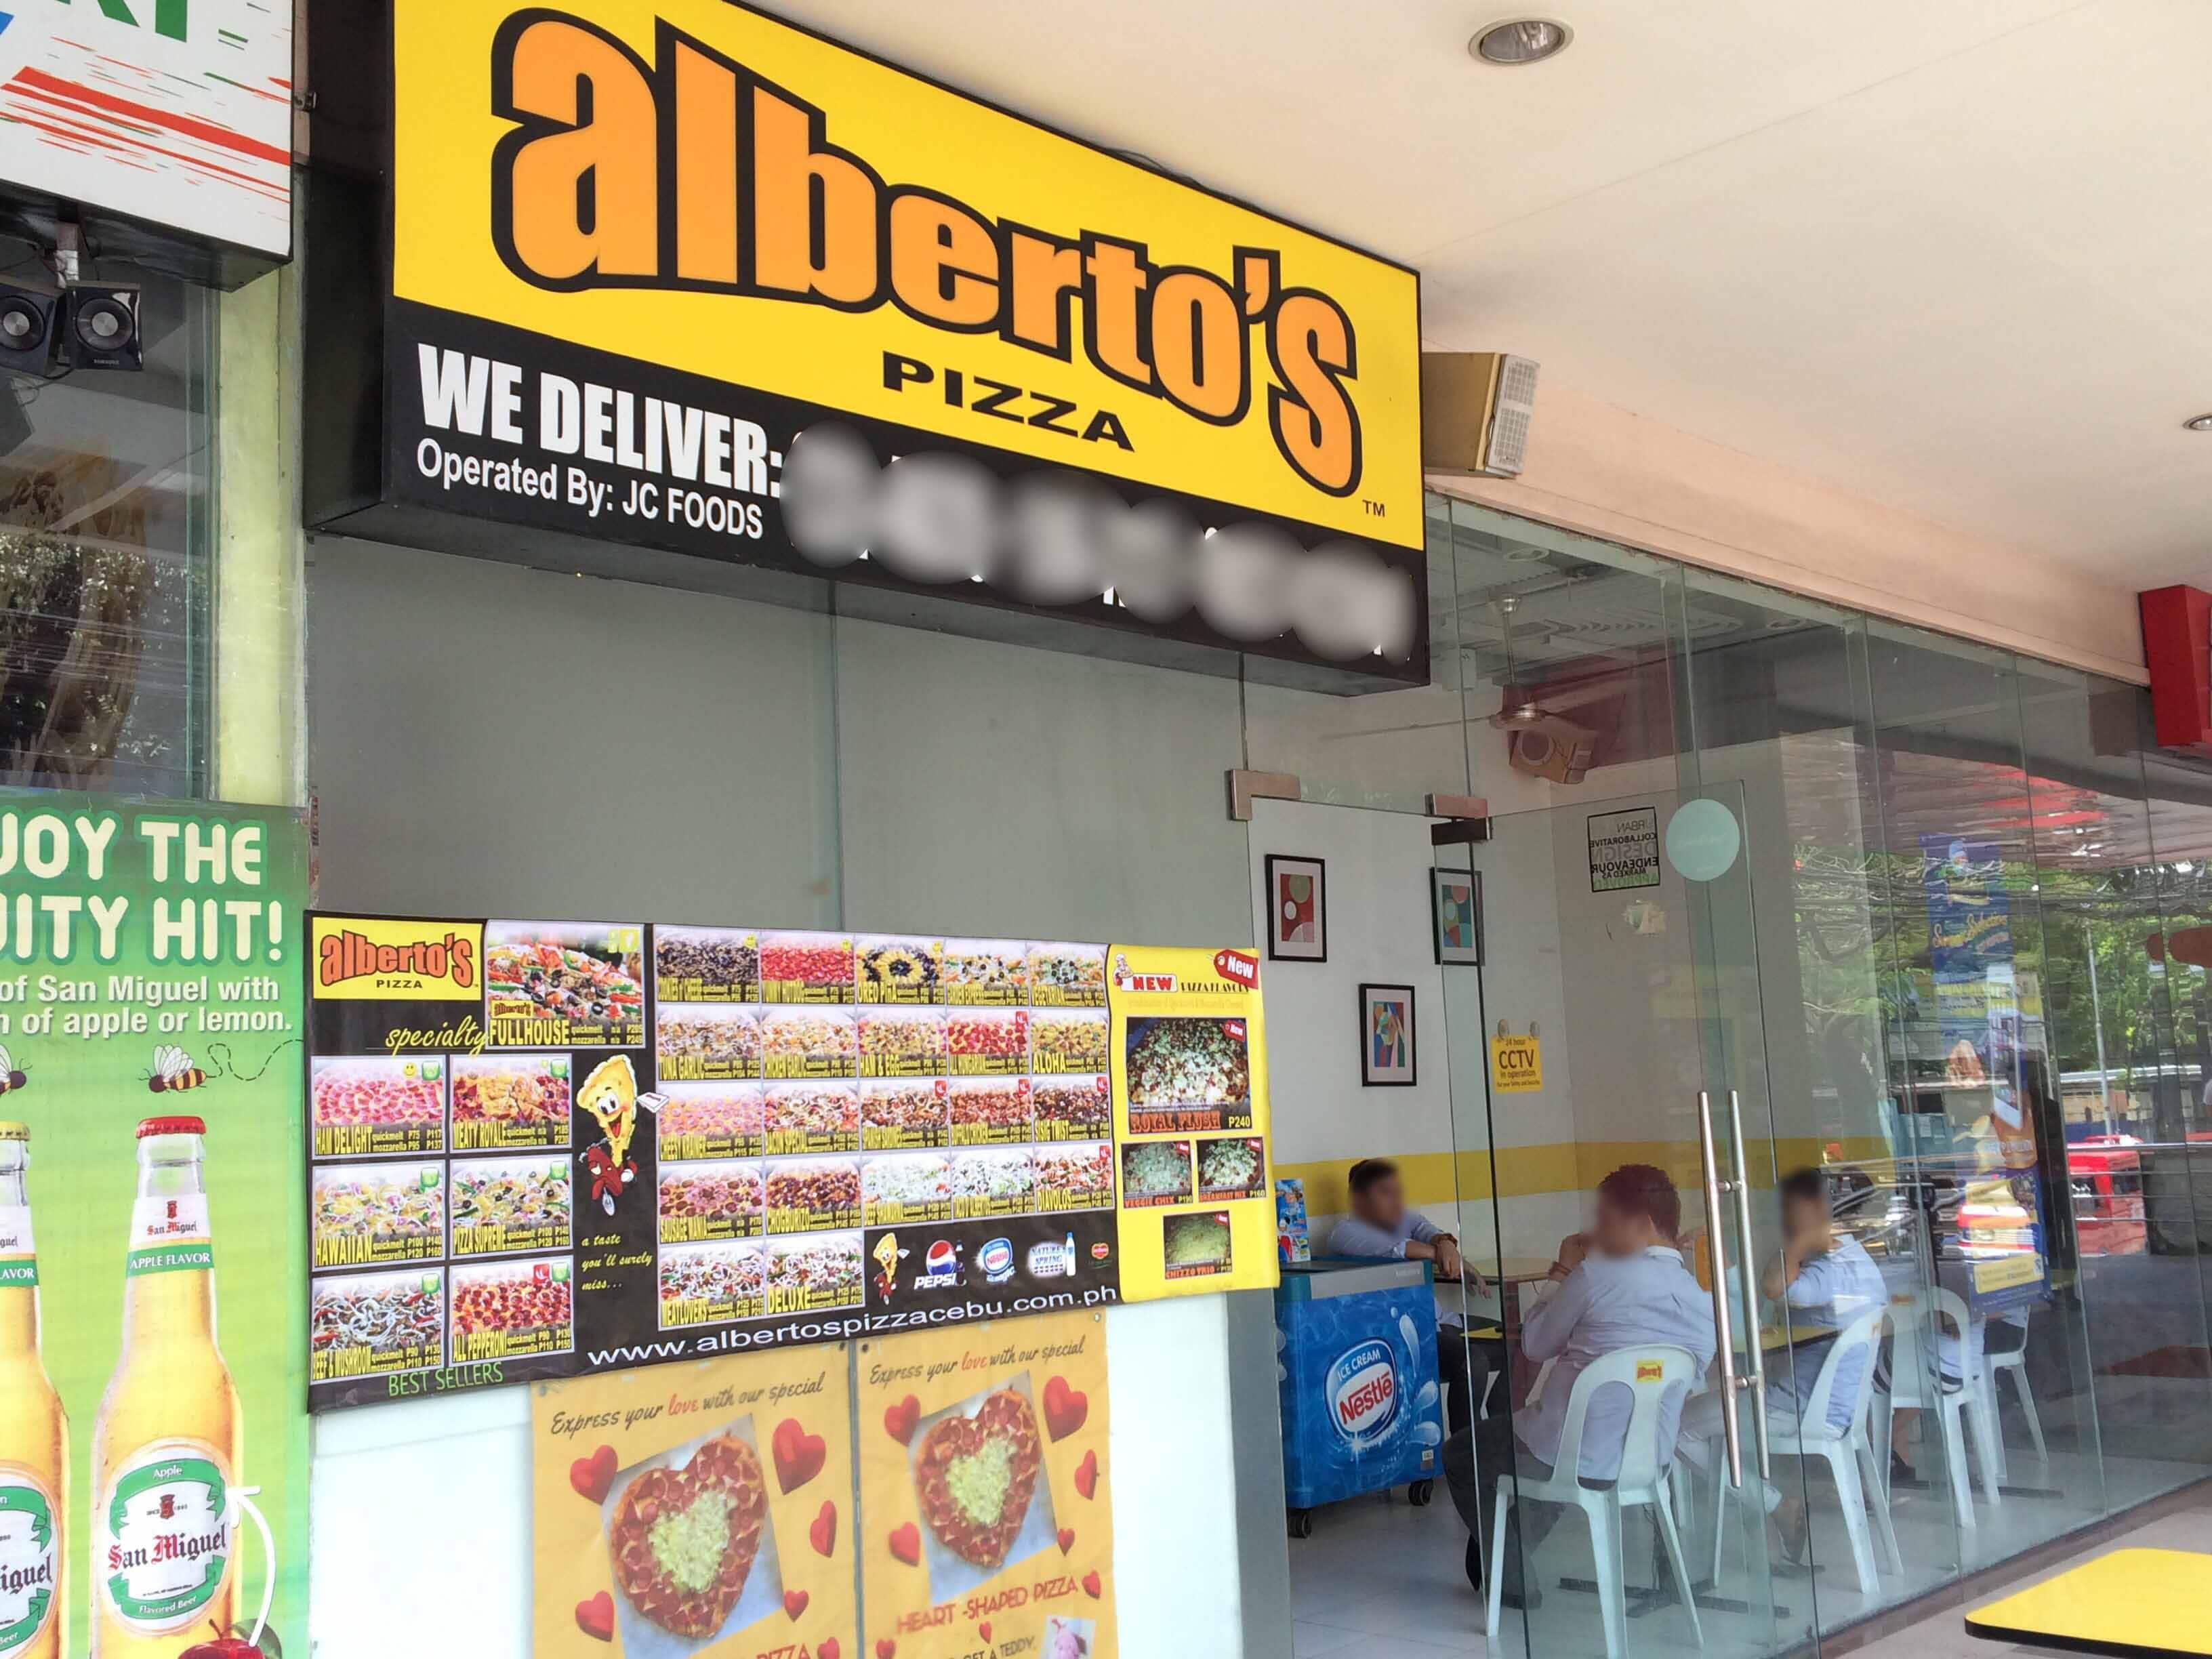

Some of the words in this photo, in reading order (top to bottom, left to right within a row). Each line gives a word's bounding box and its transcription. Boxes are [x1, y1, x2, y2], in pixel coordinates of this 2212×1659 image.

[491, 6, 1361, 498] alberto's
[882, 350, 1134, 453] PIZZA
[418, 343, 523, 445] WE
[540, 371, 782, 498] DELIVER:
[417, 438, 557, 500] Operated
[568, 468, 613, 517] By:
[622, 479, 659, 520] JC
[668, 489, 764, 539] FOODS
[1362, 499, 1386, 517] TM
[141, 821, 261, 885] THE
[0, 893, 129, 960] ITY
[153, 897, 282, 961] HIT!
[321, 929, 473, 987] alberto's
[1227, 955, 1254, 979] New
[0, 976, 27, 1001] of
[38, 975, 96, 1002] San
[108, 976, 207, 1007] Miguel
[218, 977, 279, 1001] with
[376, 979, 423, 989] PIZZA
[858, 981, 879, 1003] OREO
[1132, 976, 1172, 991] NEW
[22, 1008, 53, 1034] of
[64, 1008, 148, 1040] apple
[158, 1016, 188, 1031] or
[198, 1008, 292, 1031] lemon.
[385, 1015, 487, 1057] specialty
[489, 1019, 570, 1044] FULLHOUSE
[1033, 1052, 1066, 1073] ALOHA
[1499, 1048, 1534, 1069] CCTV
[373, 1130, 404, 1143] quickmelt
[453, 1122, 478, 1149] MEATY
[480, 1120, 506, 1148] ROYALE
[1130, 1112, 1175, 1133] ROYAL
[1229, 1115, 1250, 1128] P240
[316, 1127, 332, 1155] HAM
[335, 1125, 373, 1153] DELIGHT
[373, 1141, 407, 1151] mozzarella
[1038, 1188, 1071, 1212] DIAVOLOS
[1124, 1197, 1152, 1208] VEGGIE
[147, 1225, 165, 1235] San
[166, 1221, 197, 1234] Miguel
[454, 1227, 473, 1254] PIZZA
[475, 1225, 506, 1253] SUPREME
[581, 1237, 589, 1247] a
[593, 1233, 621, 1246] taste
[129, 1256, 163, 1270] APPLE
[166, 1252, 211, 1266] FLAVOR
[315, 1235, 373, 1267] HAWAIIAN
[581, 1253, 616, 1272] you'll
[619, 1252, 653, 1269] surely
[914, 1273, 957, 1290] PEPSI
[661, 1298, 709, 1326] MEATLOVERS
[767, 1286, 811, 1314] DELUXE
[587, 1286, 1117, 1366] www.albertospizzacebu.com.ph
[453, 1334, 467, 1362] ALL
[468, 1330, 507, 1360] PEPPERONI
[869, 1363, 922, 1389] Express
[927, 1359, 958, 1382] your
[962, 1351, 987, 1372] love
[989, 1345, 1017, 1367] with
[1019, 1348, 1038, 1363] our
[1042, 1334, 1086, 1363] special
[1337, 1368, 1352, 1382] ICE
[1351, 1347, 1381, 1371] CREAM
[388, 1370, 431, 1397] BEST
[435, 1361, 505, 1390] SELLERS
[550, 1411, 619, 1440] Express
[625, 1405, 663, 1431] your
[668, 1393, 699, 1416] love
[702, 1385, 735, 1411] with
[738, 1388, 765, 1406] our
[769, 1371, 826, 1405] special
[152, 1466, 183, 1479] Apple
[108, 1544, 148, 1571] San
[151, 1523, 226, 1564] Miguel
[140, 1601, 176, 1614] Flavored
[178, 1595, 197, 1610] Beer
[895, 1603, 956, 1634] HEART
[1033, 1576, 1079, 1602] PIZZA
